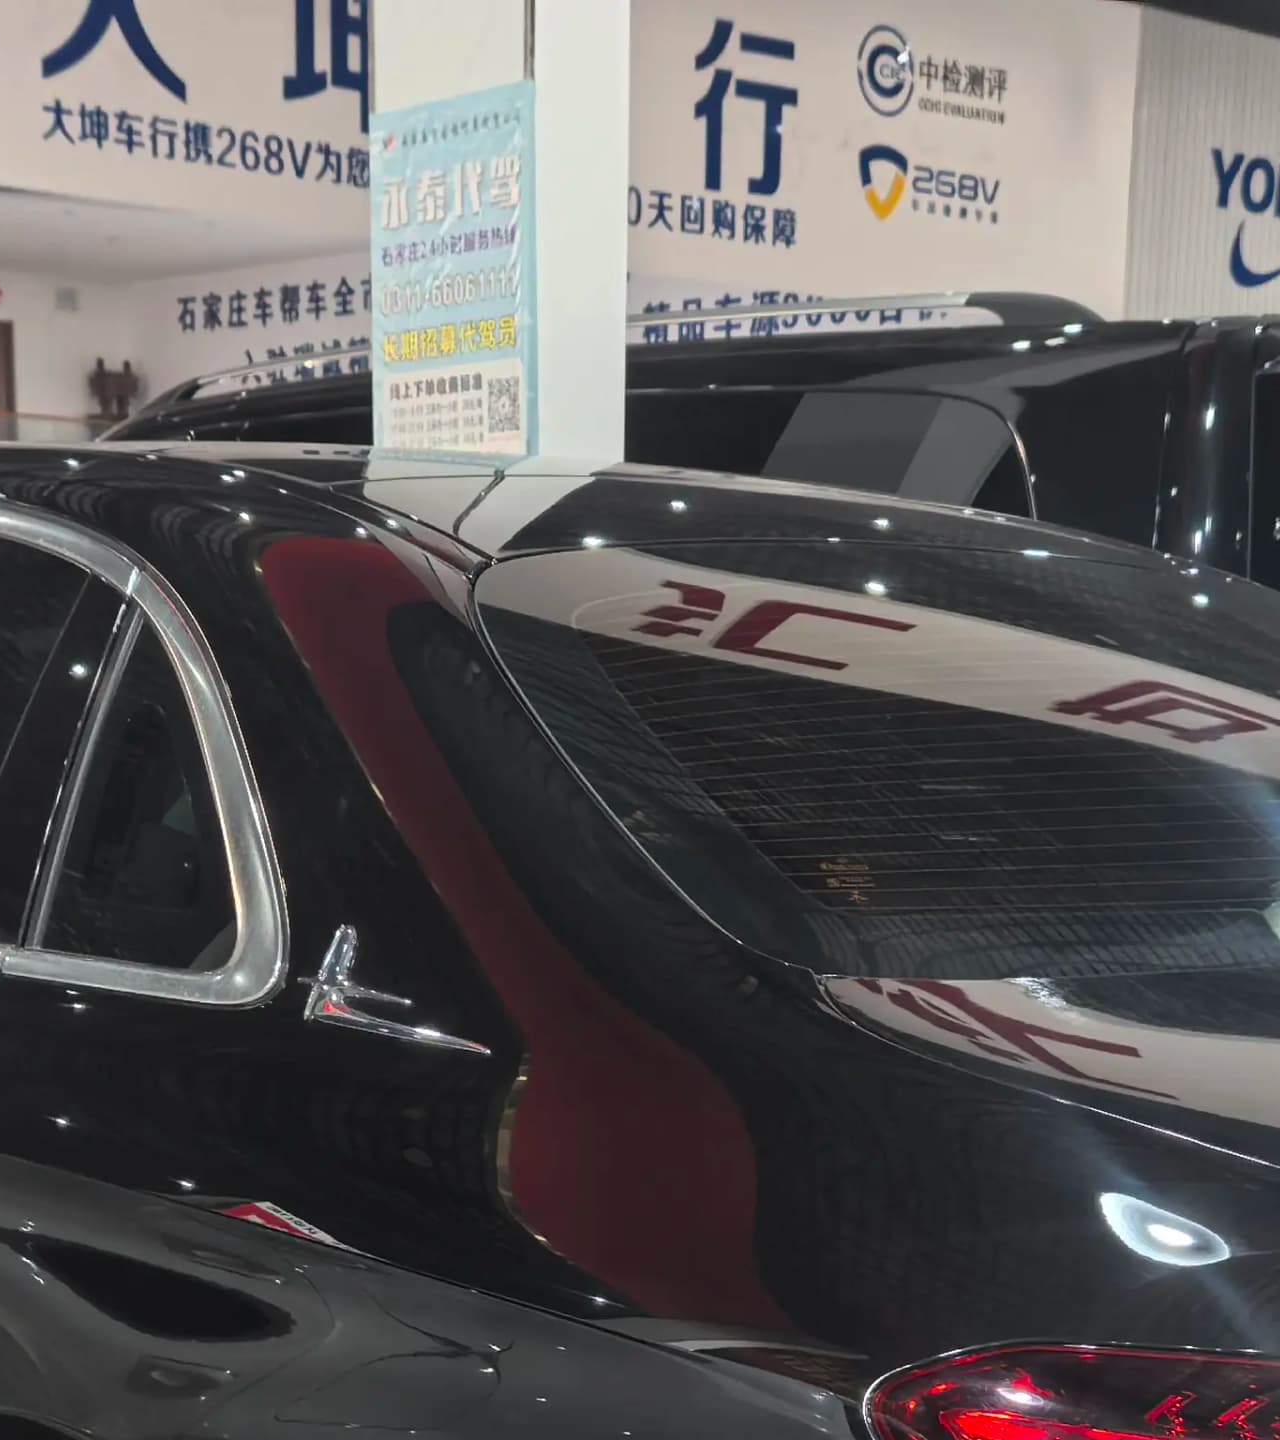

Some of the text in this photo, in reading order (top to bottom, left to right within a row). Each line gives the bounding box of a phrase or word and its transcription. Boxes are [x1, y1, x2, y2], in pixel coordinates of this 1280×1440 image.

[919, 54, 1008, 104] 中检测评
[694, 17, 798, 196] 行
[913, 164, 1000, 205] 268V
[383, 314, 517, 363] 长期招募代驾员
